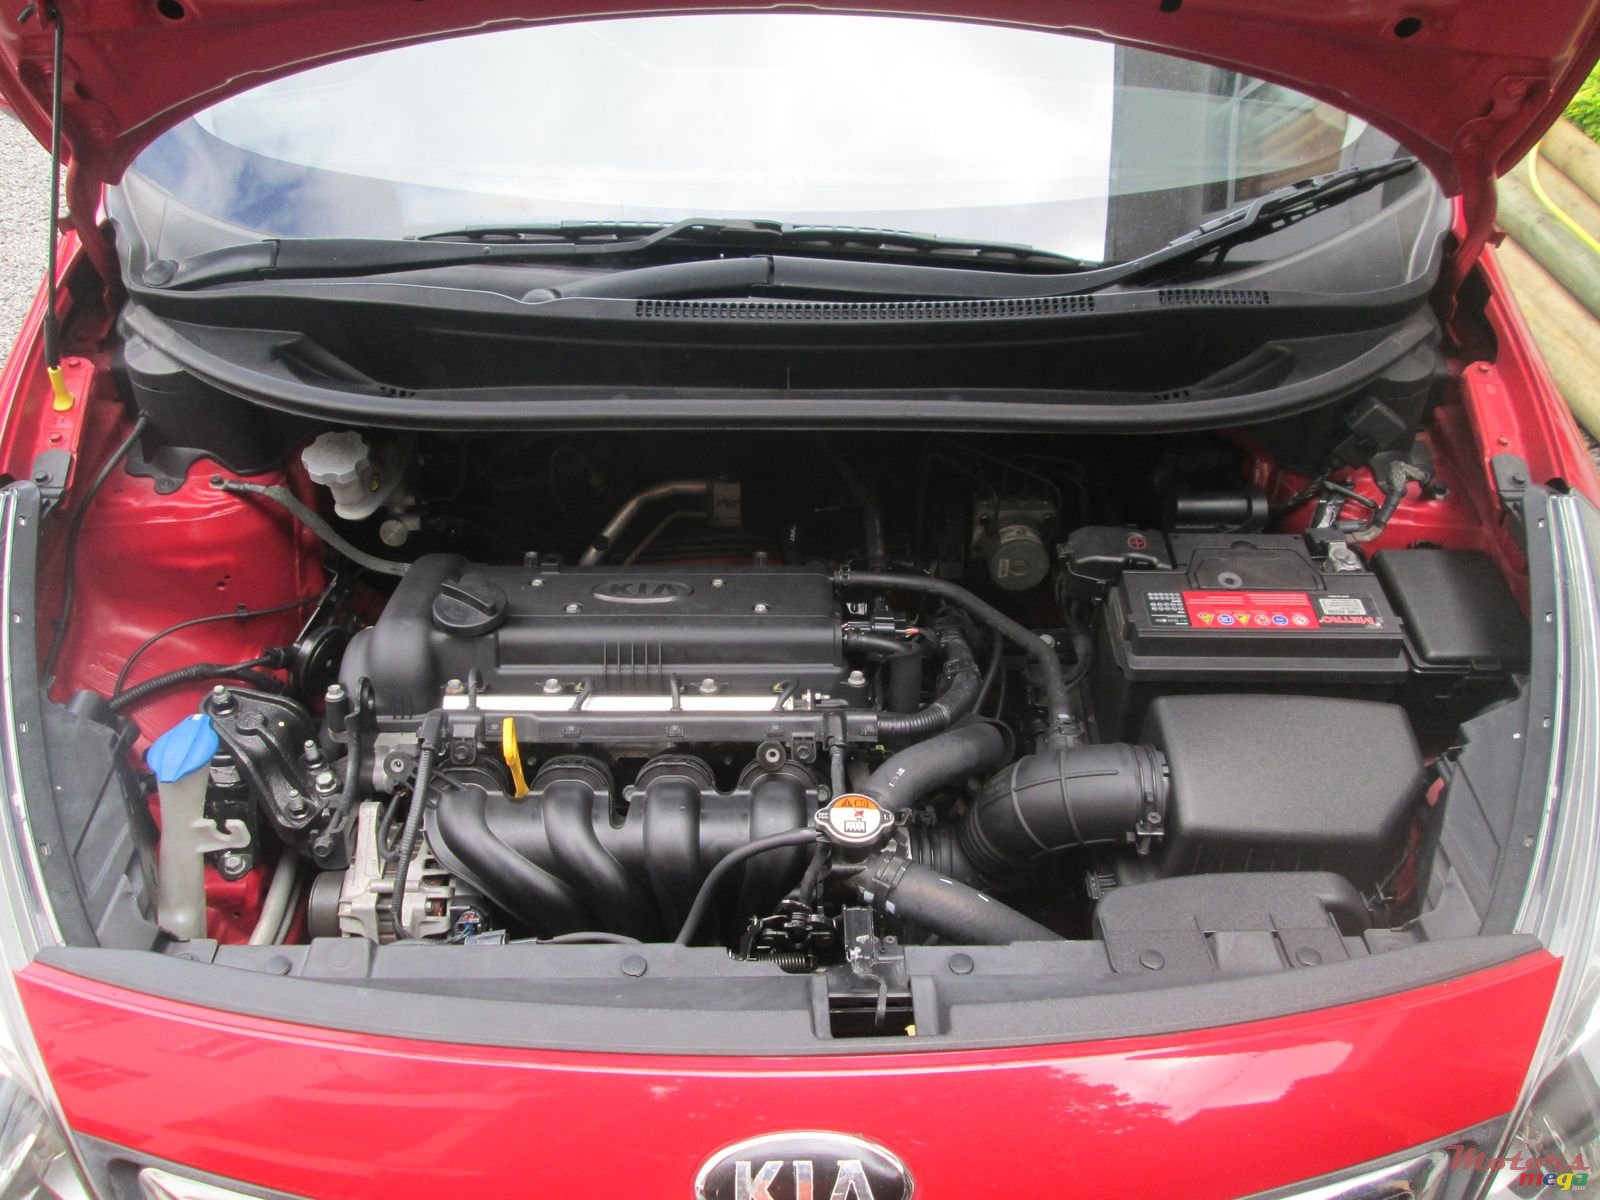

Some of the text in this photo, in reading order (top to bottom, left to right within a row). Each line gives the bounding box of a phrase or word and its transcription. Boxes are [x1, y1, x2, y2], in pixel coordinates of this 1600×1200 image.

[609, 583, 677, 595] KIA
[1319, 615, 1374, 624] METRO
[883, 813, 892, 821] 1.1
[735, 1159, 876, 1200] KIA
